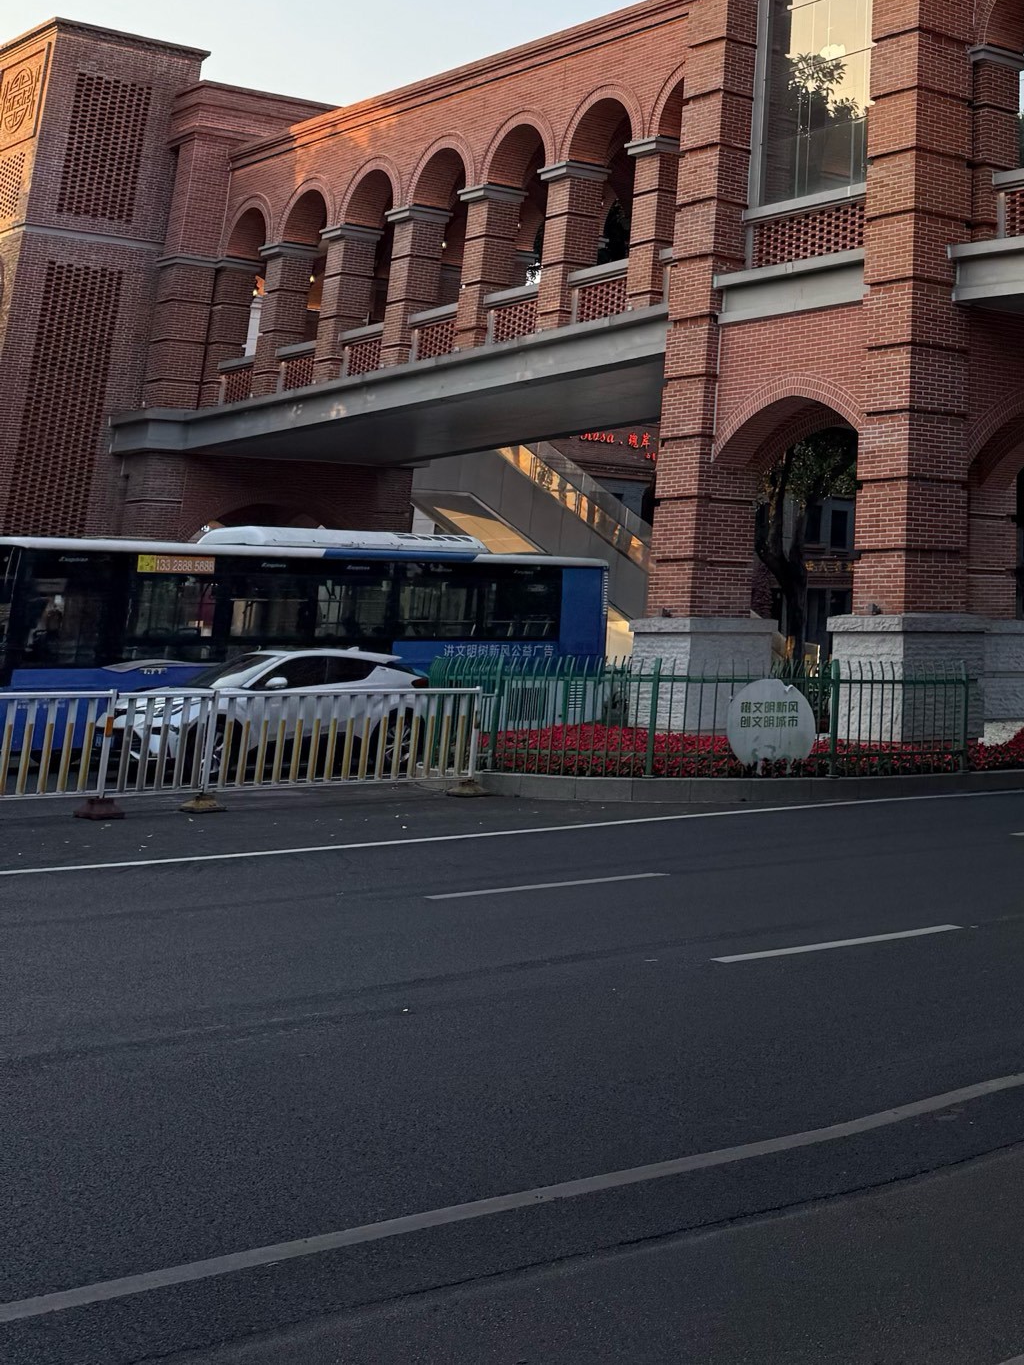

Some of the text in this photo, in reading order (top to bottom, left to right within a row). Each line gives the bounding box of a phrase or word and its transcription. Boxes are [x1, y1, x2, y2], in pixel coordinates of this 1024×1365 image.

[443, 643, 555, 657] 讲文明树新风公益广告
[740, 715, 799, 728] 创文明城市
